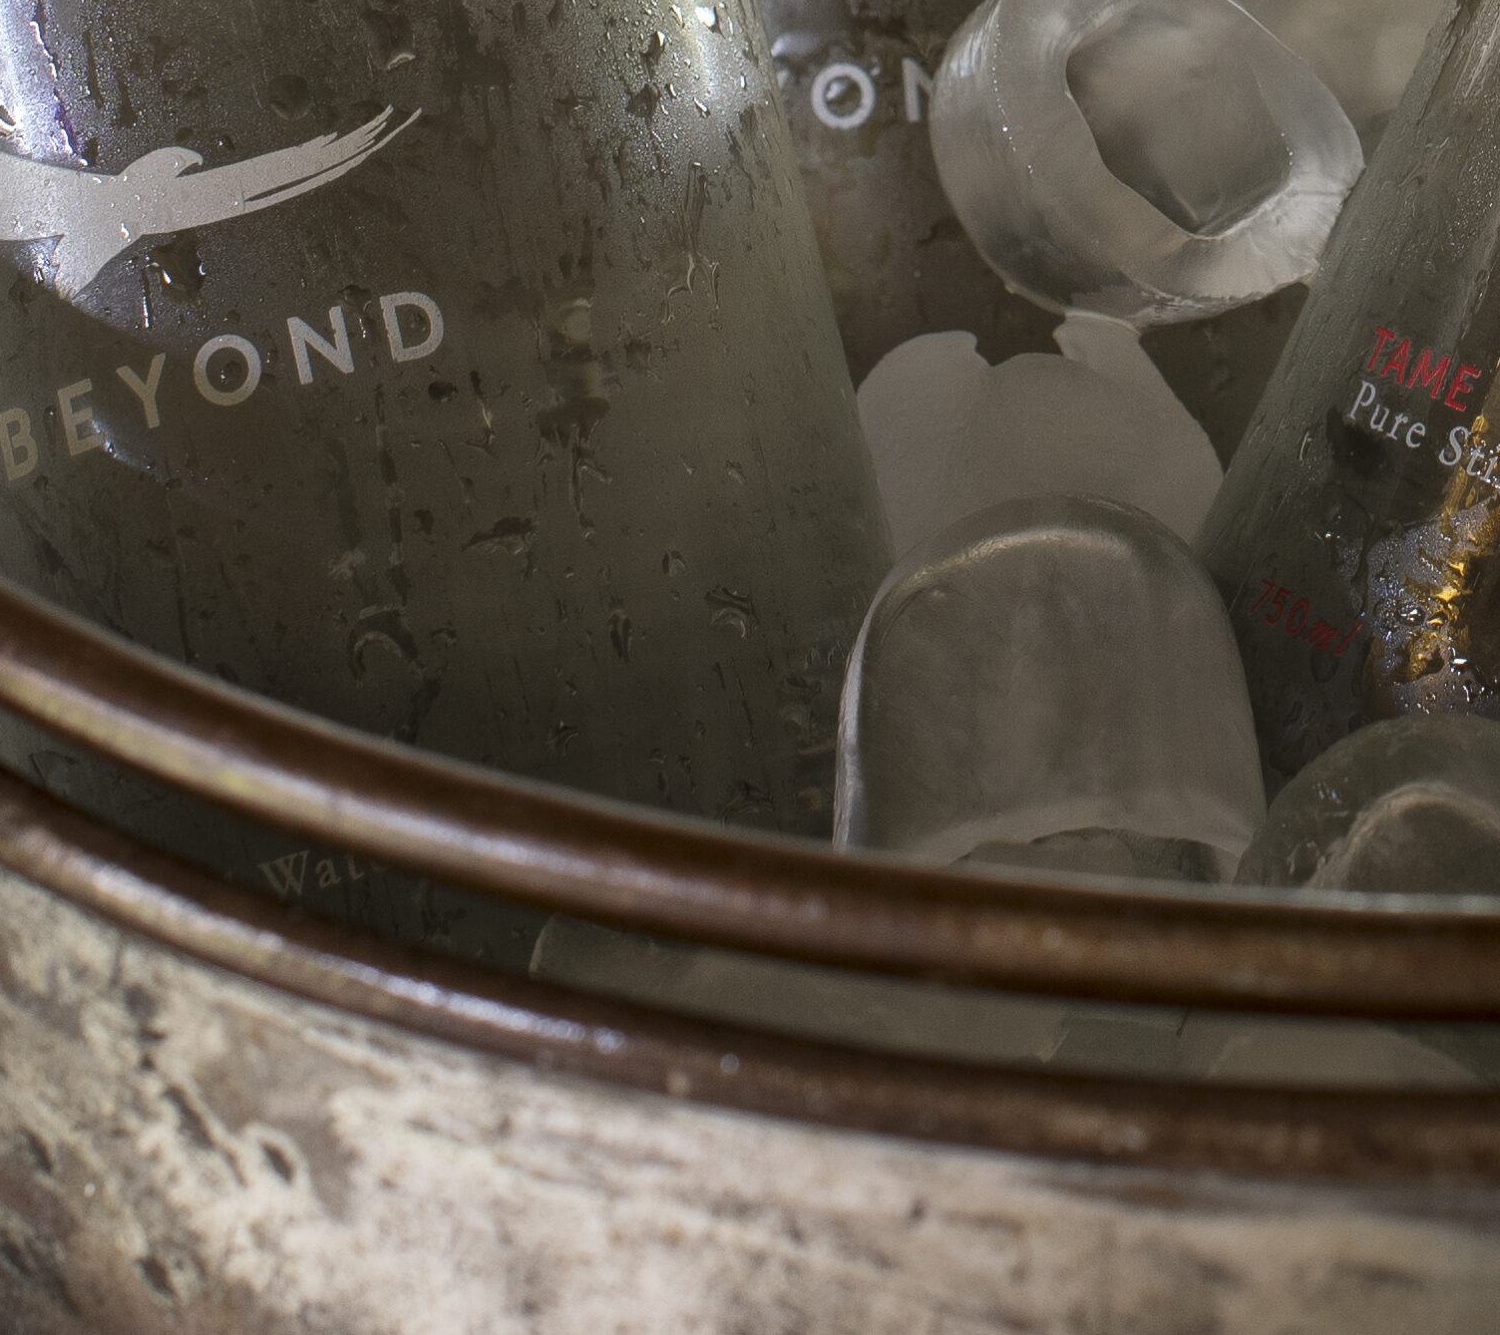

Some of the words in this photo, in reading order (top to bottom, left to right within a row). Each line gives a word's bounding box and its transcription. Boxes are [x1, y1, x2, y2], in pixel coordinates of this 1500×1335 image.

[1364, 326, 1481, 412] TAME
[1348, 380, 1426, 450] Pure
[1248, 578, 1362, 656] 750ml
